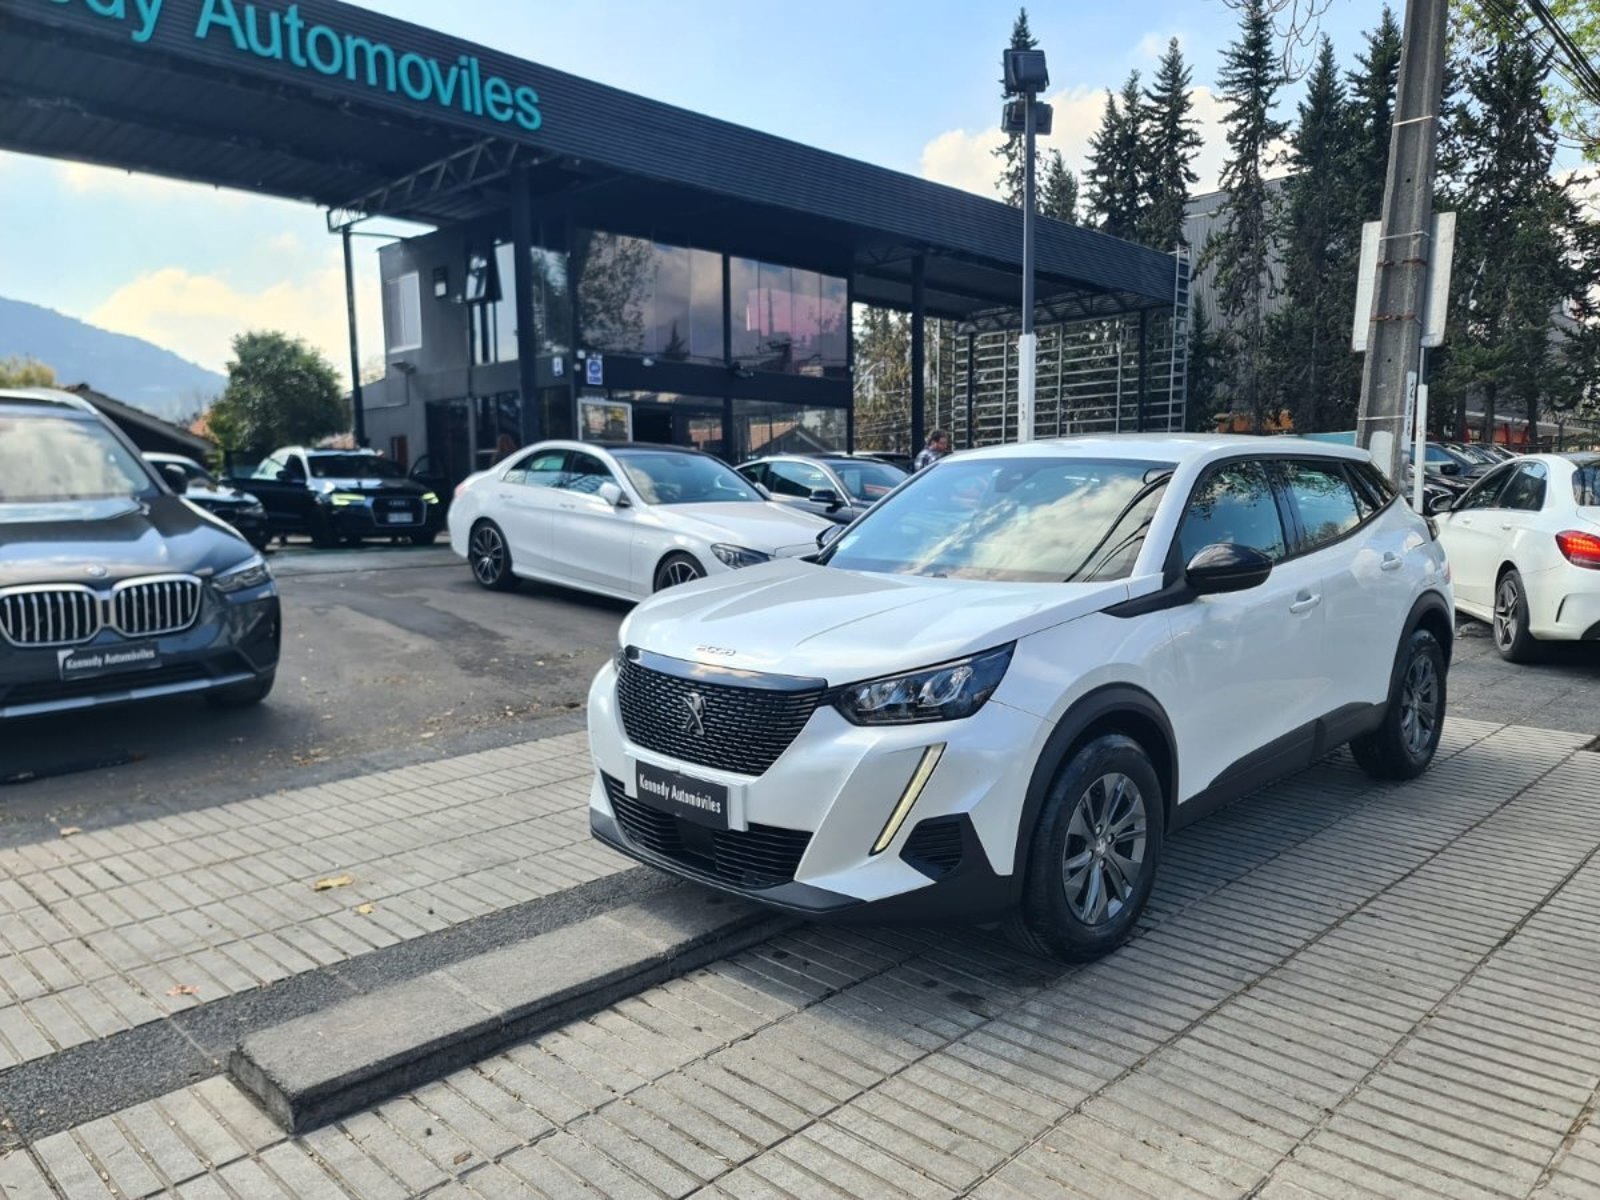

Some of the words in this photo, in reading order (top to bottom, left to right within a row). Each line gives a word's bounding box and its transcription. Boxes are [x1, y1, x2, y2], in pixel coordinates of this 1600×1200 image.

[195, 0, 542, 130] Automoviles
[640, 773, 670, 800] Kennedy
[671, 784, 721, 814] Automóviles
